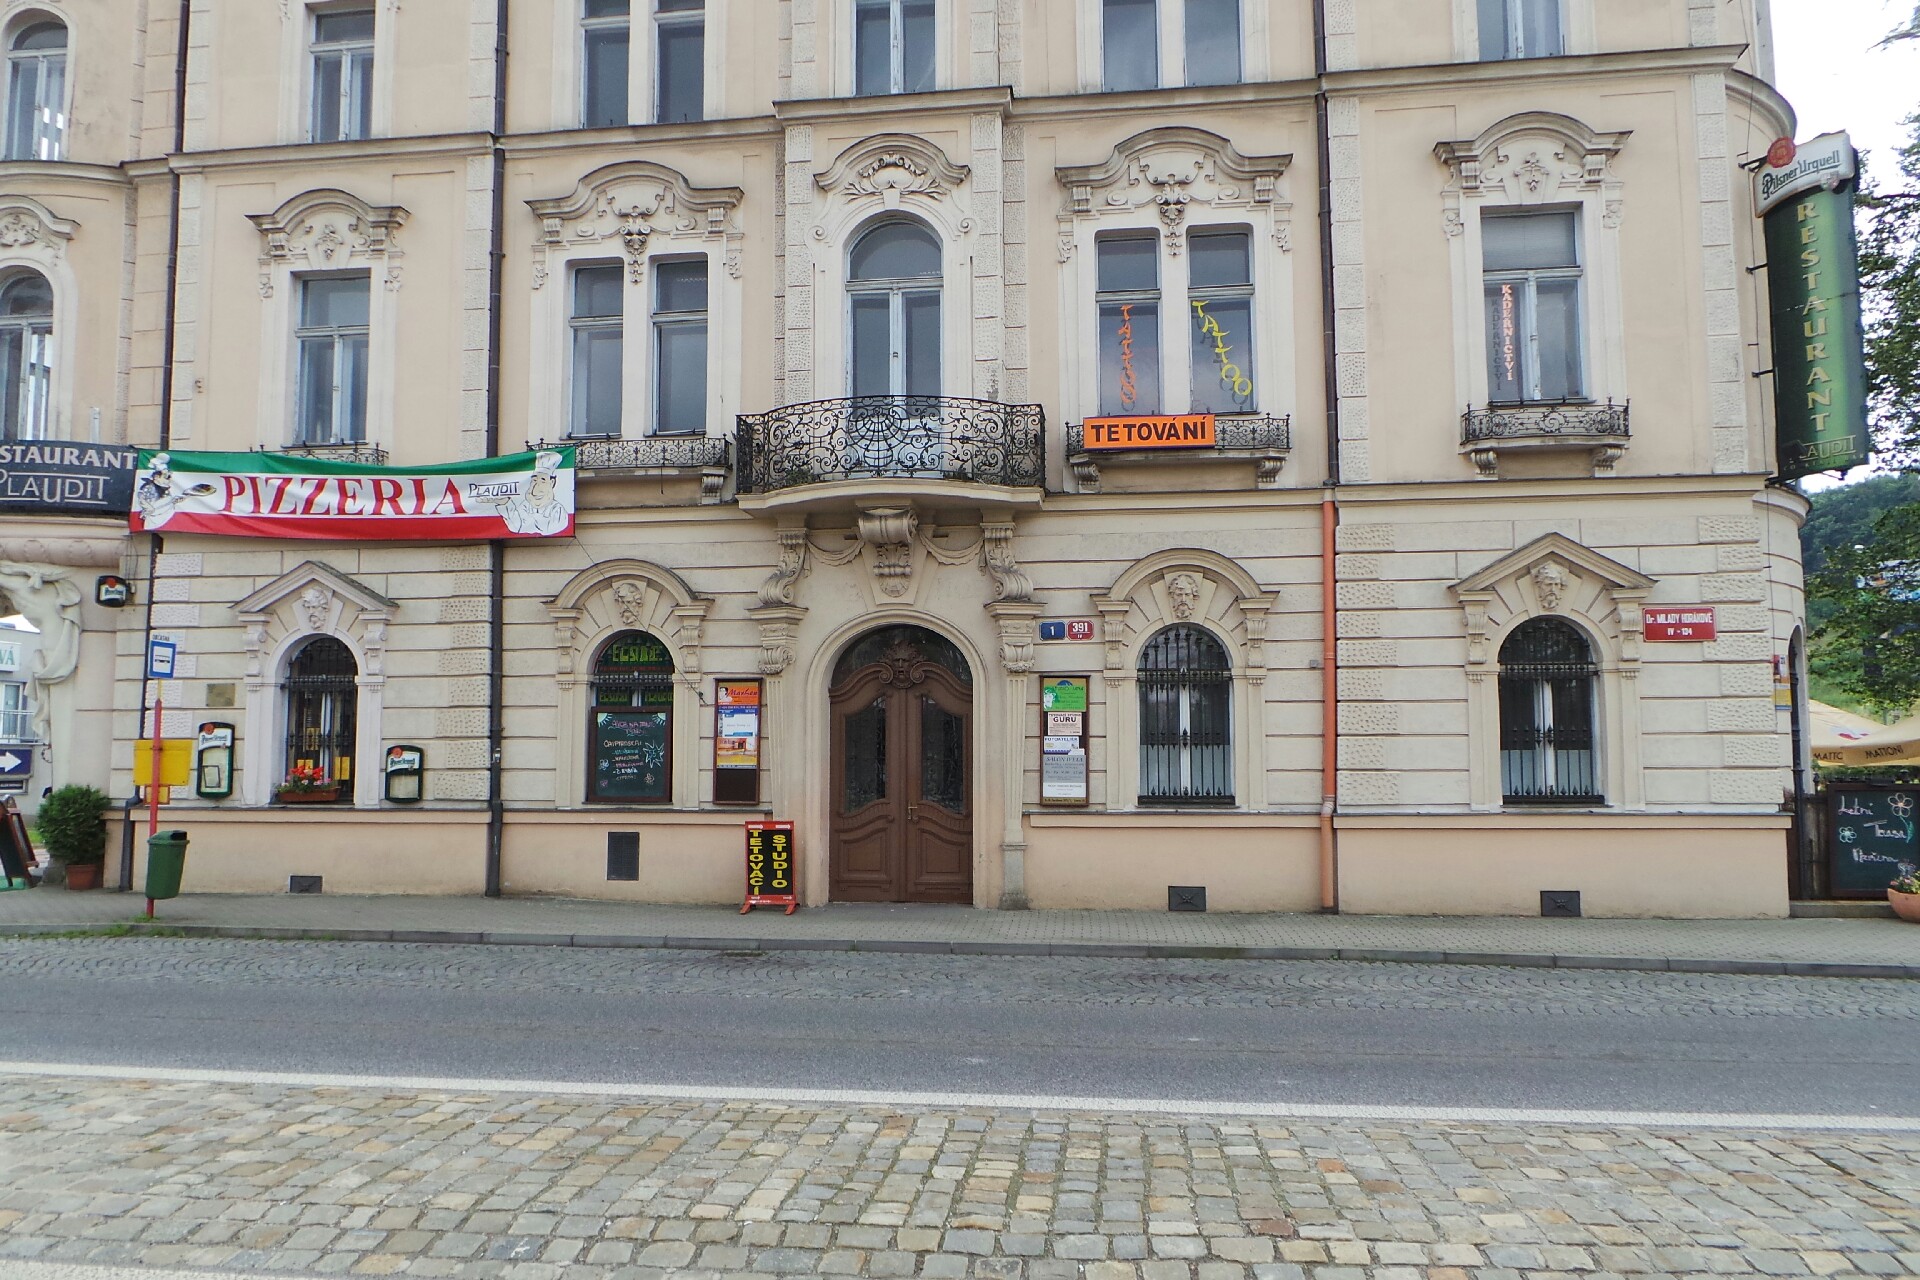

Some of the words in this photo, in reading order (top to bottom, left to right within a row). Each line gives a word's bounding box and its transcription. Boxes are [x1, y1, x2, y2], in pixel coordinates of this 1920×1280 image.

[1762, 167, 1798, 200] Pilsner
[1798, 150, 1840, 175] Urquell
[1797, 202, 1832, 433] RESTAURANT
[1192, 300, 1252, 396] TATTOO
[1090, 416, 1207, 443] TETOVÁNÍ
[220, 475, 469, 515] PIZZERIA
[468, 482, 520, 498] PLAUDIT
[1050, 626, 1055, 636] 1
[1072, 622, 1088, 632] 391
[1864, 745, 1904, 759] MATTONI
[772, 834, 788, 888] STUDIO
